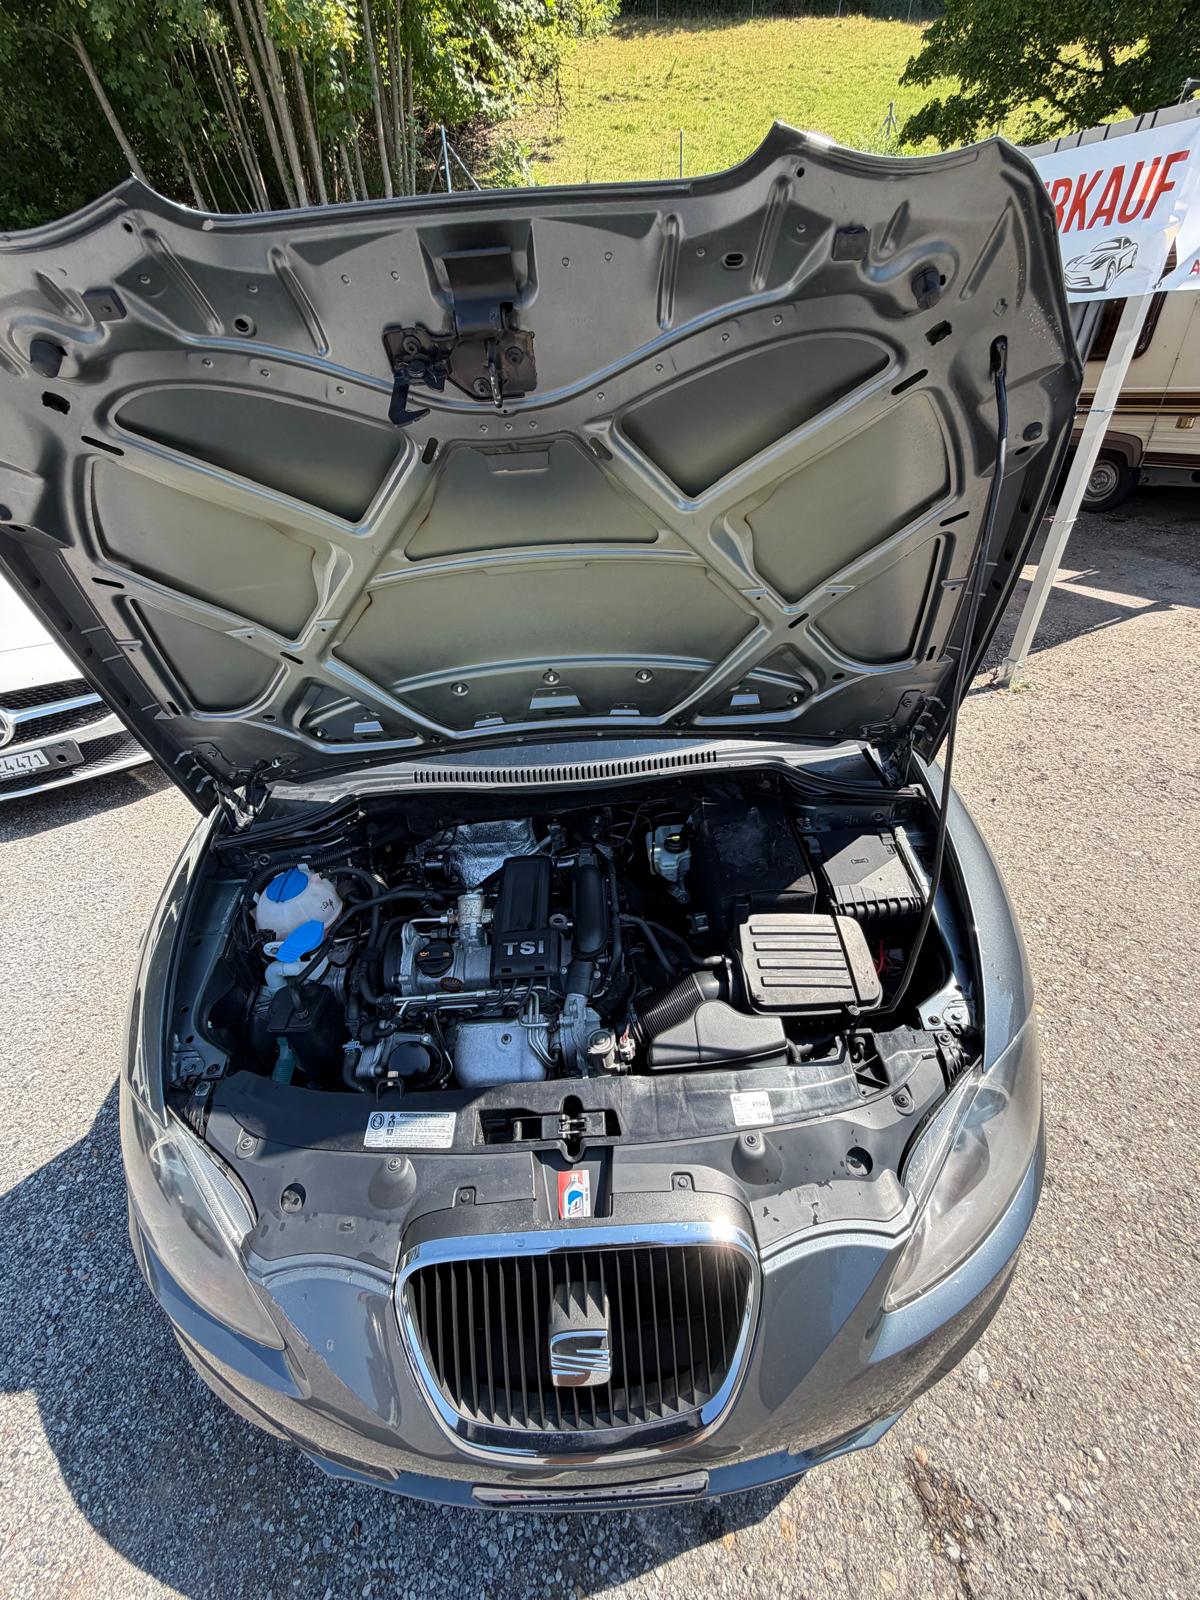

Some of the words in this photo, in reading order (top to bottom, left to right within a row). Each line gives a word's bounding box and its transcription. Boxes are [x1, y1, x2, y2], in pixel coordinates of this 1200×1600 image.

[1045, 150, 1190, 233] RKAUF
[0, 754, 45, 773] 4471
[503, 940, 545, 956] TSI
